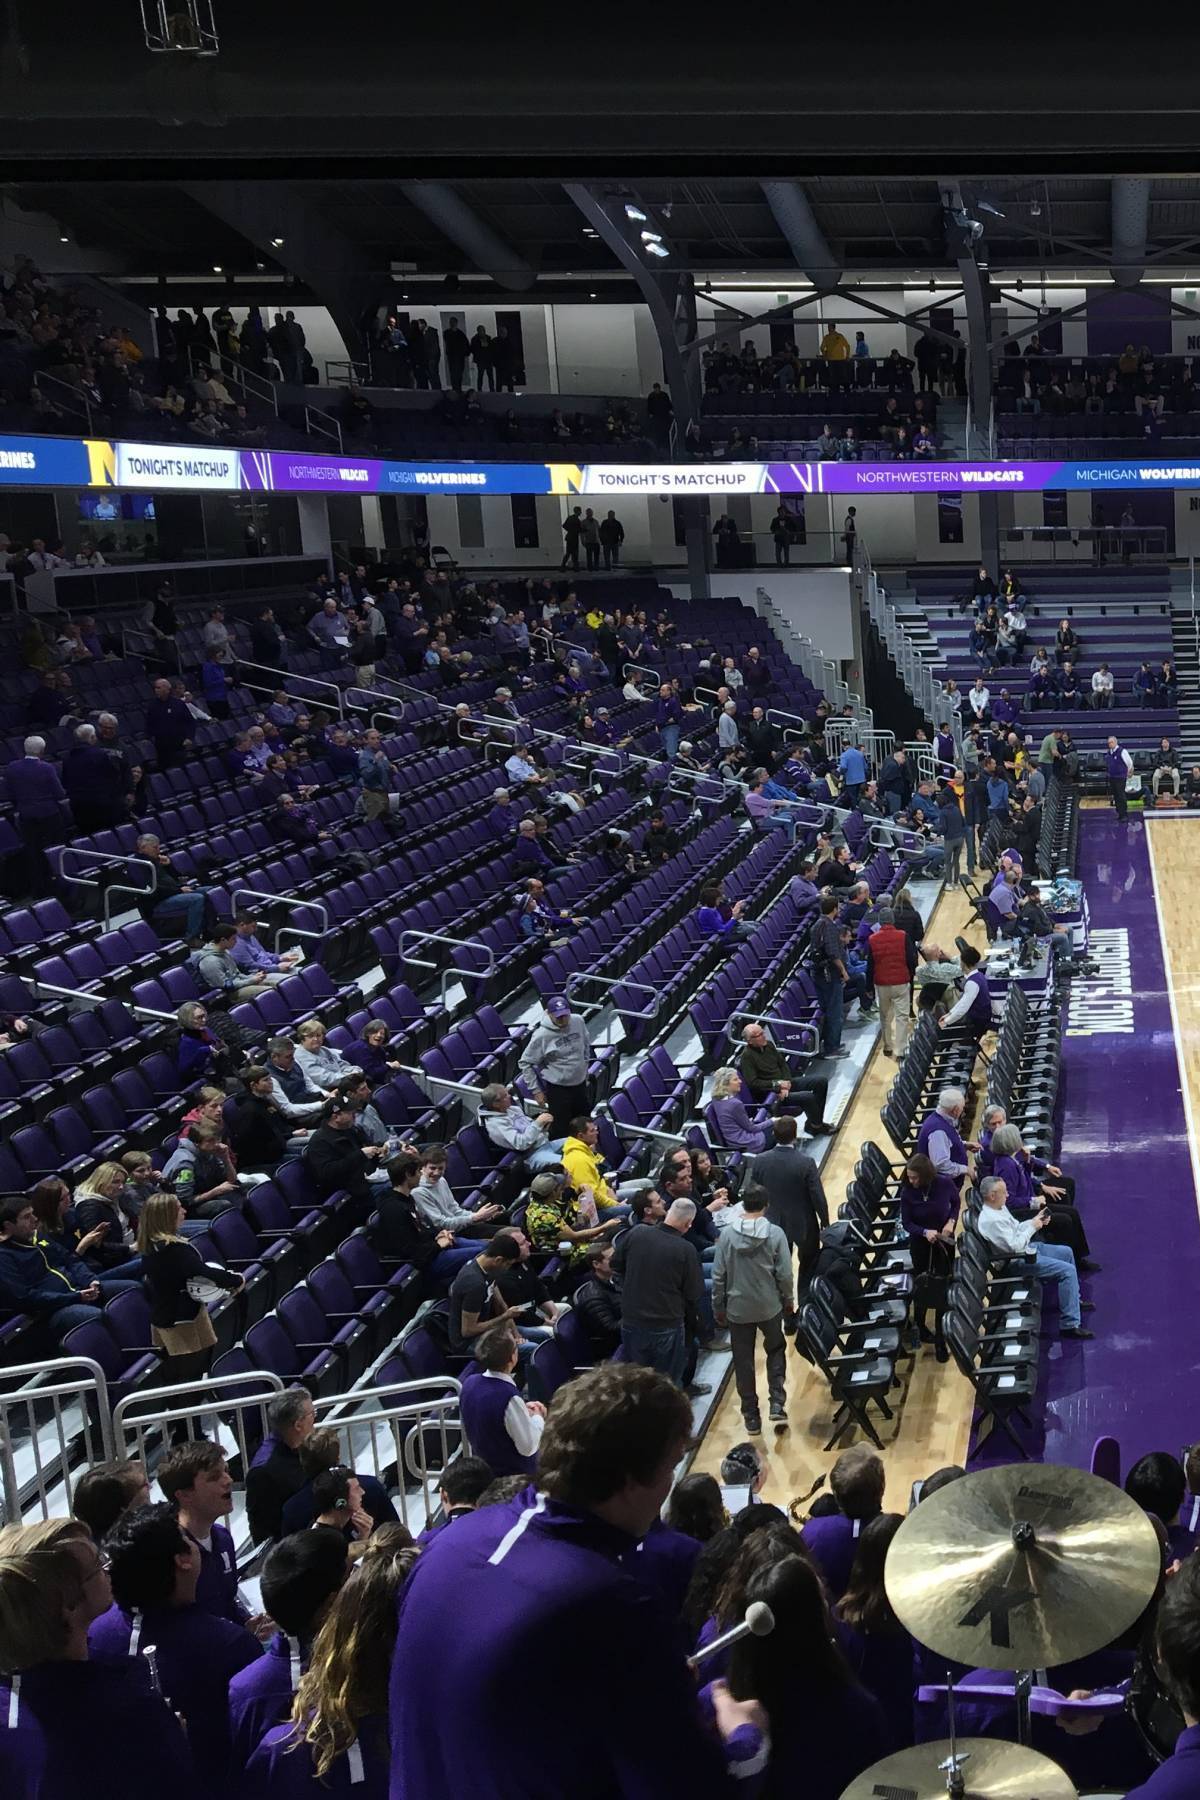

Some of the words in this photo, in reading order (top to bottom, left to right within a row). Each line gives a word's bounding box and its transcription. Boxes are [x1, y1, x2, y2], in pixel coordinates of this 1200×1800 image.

[128, 457, 182, 477] TONIGHT'S
[183, 460, 229, 478] MATCHUP
[599, 473, 671, 486] TONIGHT'S
[674, 473, 745, 486] MATCHUP
[856, 470, 959, 484] NORTHWESTERN
[961, 470, 1024, 483] WILDCATS
[1076, 469, 1137, 481] MICHIGAN
